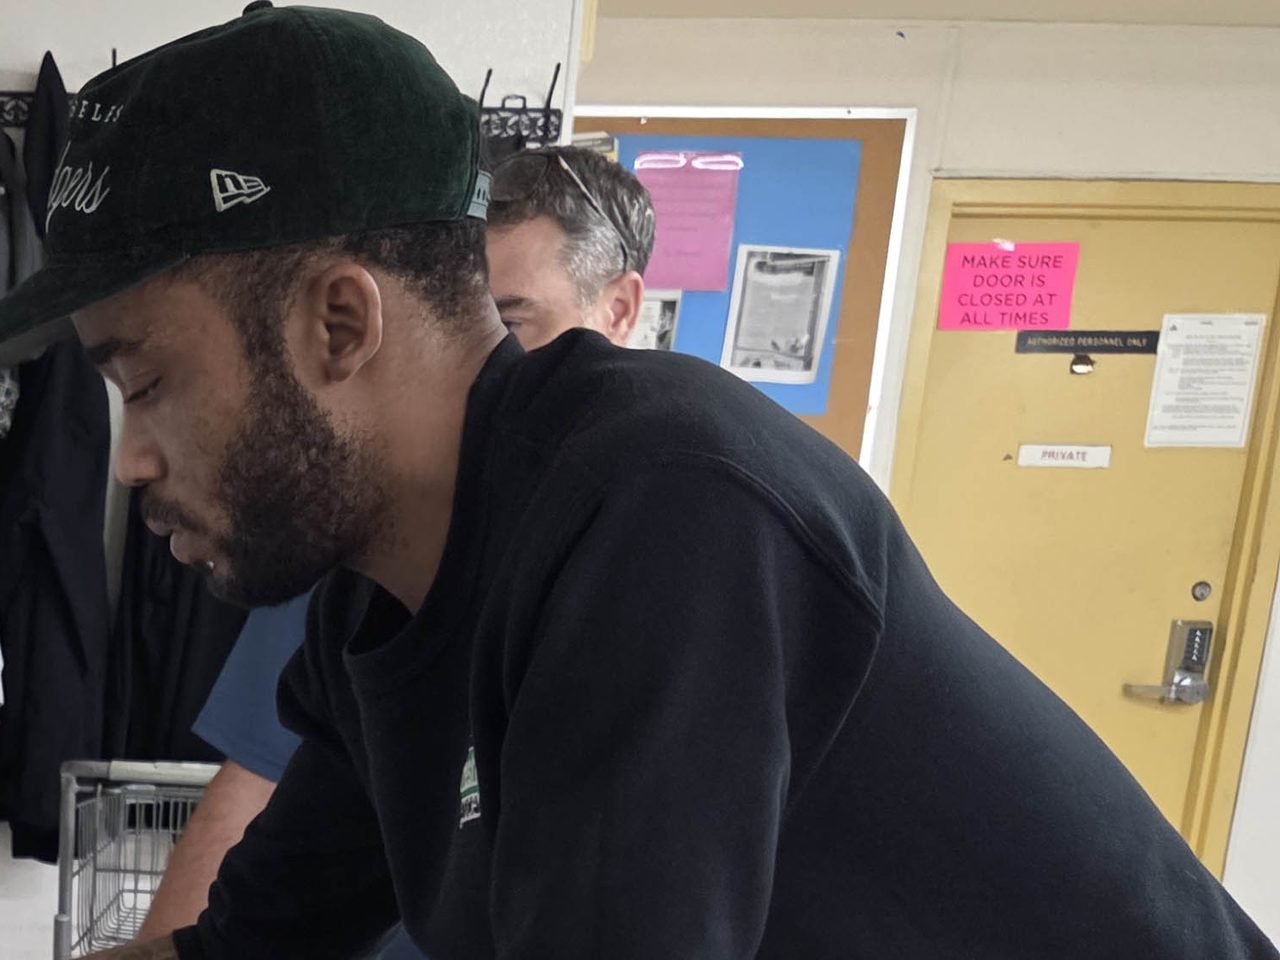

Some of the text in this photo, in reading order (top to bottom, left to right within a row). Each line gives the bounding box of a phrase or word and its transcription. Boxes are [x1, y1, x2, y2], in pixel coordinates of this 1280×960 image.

[961, 255, 1064, 269] MAKE SURE
[973, 274, 1047, 287] DOOR IS
[957, 292, 1058, 307] CLOSED AT
[959, 312, 1049, 326] ALL TIMES
[1027, 337, 1148, 347] AUTHORIZED PERSONNEL ONLY
[1041, 450, 1088, 462] PRIVATE
